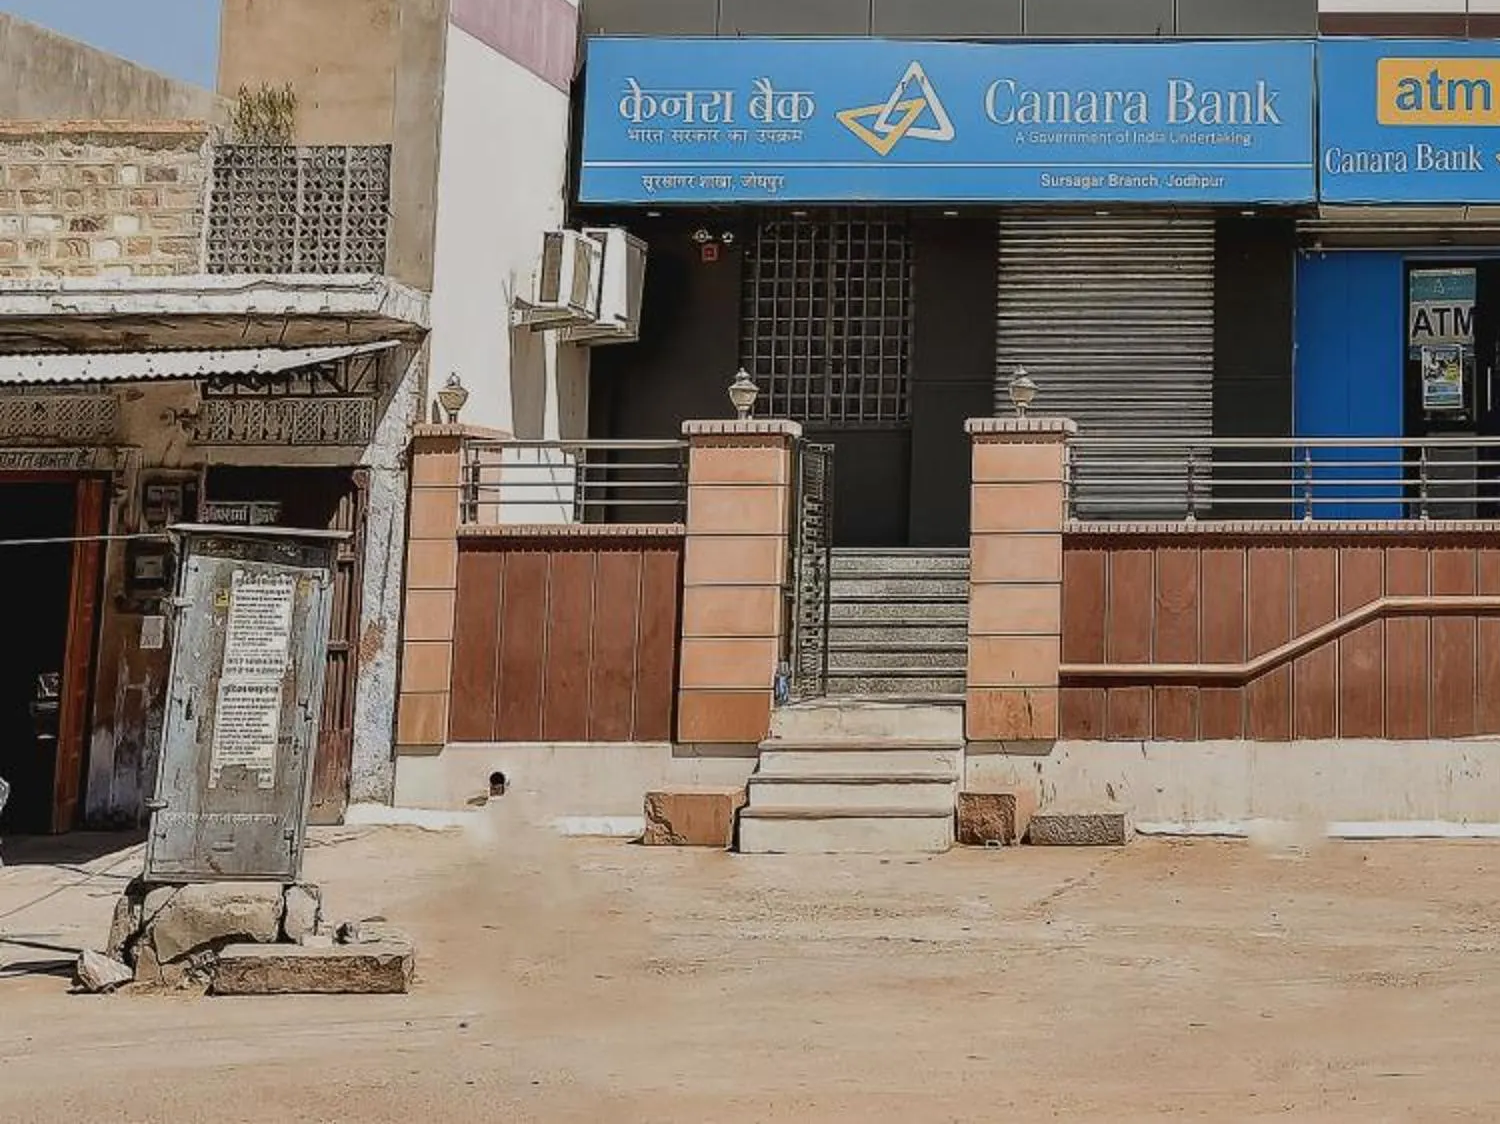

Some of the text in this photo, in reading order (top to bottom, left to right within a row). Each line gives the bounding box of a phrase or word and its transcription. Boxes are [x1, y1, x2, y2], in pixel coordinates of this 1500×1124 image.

[618, 76, 734, 124] केनरा
[984, 78, 1281, 125] Canara Bank
[1395, 70, 1491, 111] atm
[627, 129, 803, 144] भारत सरकार का उपक्रम
[1015, 131, 1252, 146] A Government of India Undertaking
[1325, 144, 1484, 174] Canara Bank
[1040, 174, 1104, 189] Sursagar
[1166, 174, 1225, 189] Jodhpur
[1412, 307, 1475, 337] ATM
